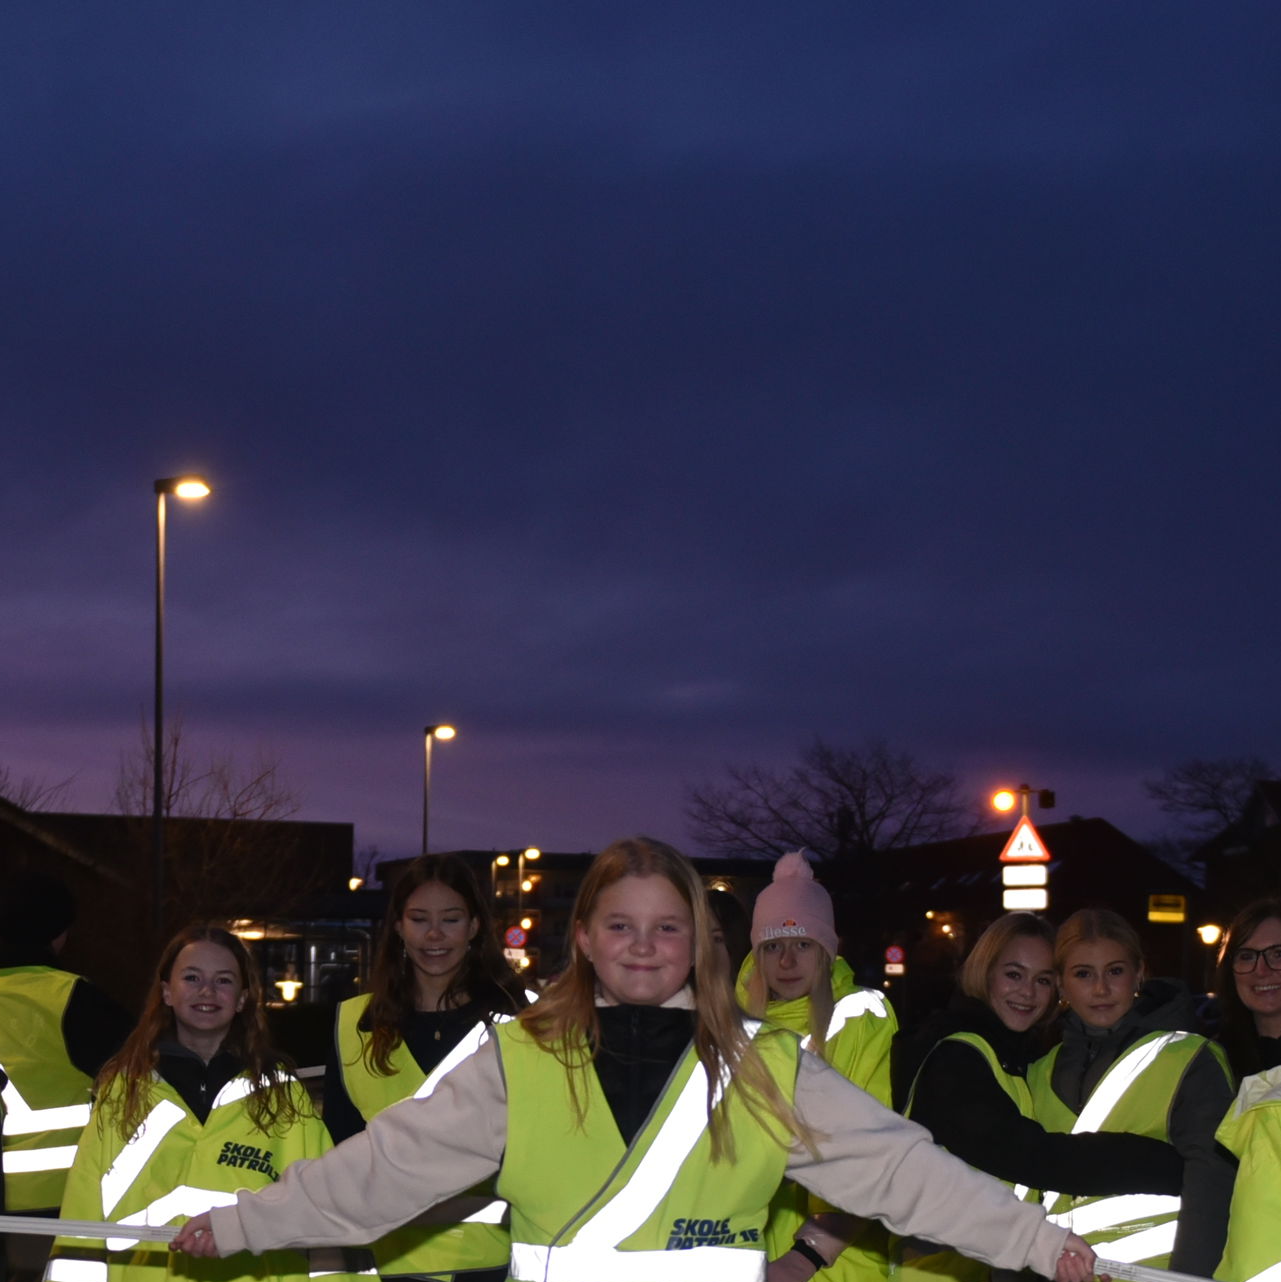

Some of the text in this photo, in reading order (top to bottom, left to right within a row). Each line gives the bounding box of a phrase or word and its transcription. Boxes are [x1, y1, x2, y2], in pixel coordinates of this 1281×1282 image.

[221, 1141, 273, 1162] SKOLE
[216, 1153, 281, 1182] PATRULJ
[671, 1218, 731, 1236] SKOLE
